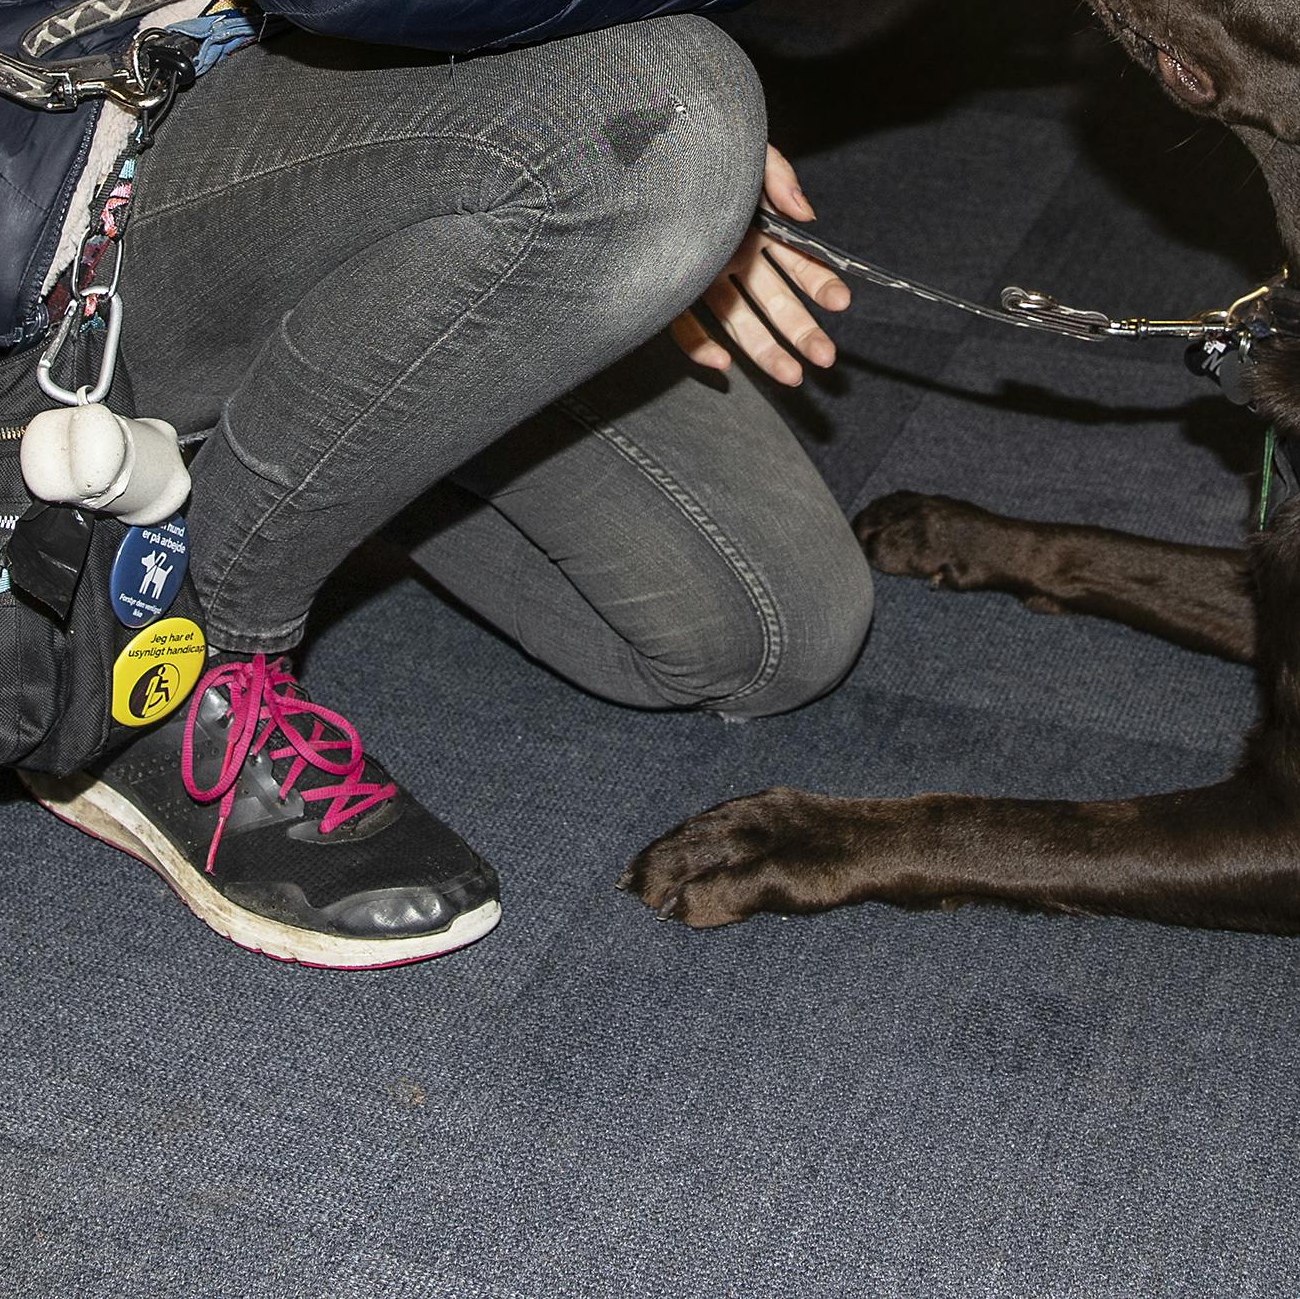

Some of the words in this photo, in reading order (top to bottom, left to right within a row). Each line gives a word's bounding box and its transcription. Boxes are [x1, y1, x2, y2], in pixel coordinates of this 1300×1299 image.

[167, 522, 186, 537] hund
[142, 529, 151, 539] er
[149, 532, 161, 544] på
[160, 537, 186, 554] arbejde
[150, 634, 167, 645] Jeg
[169, 633, 184, 642] har
[184, 632, 194, 641] et
[128, 647, 166, 659] usynligt
[166, 644, 205, 655] handicap
